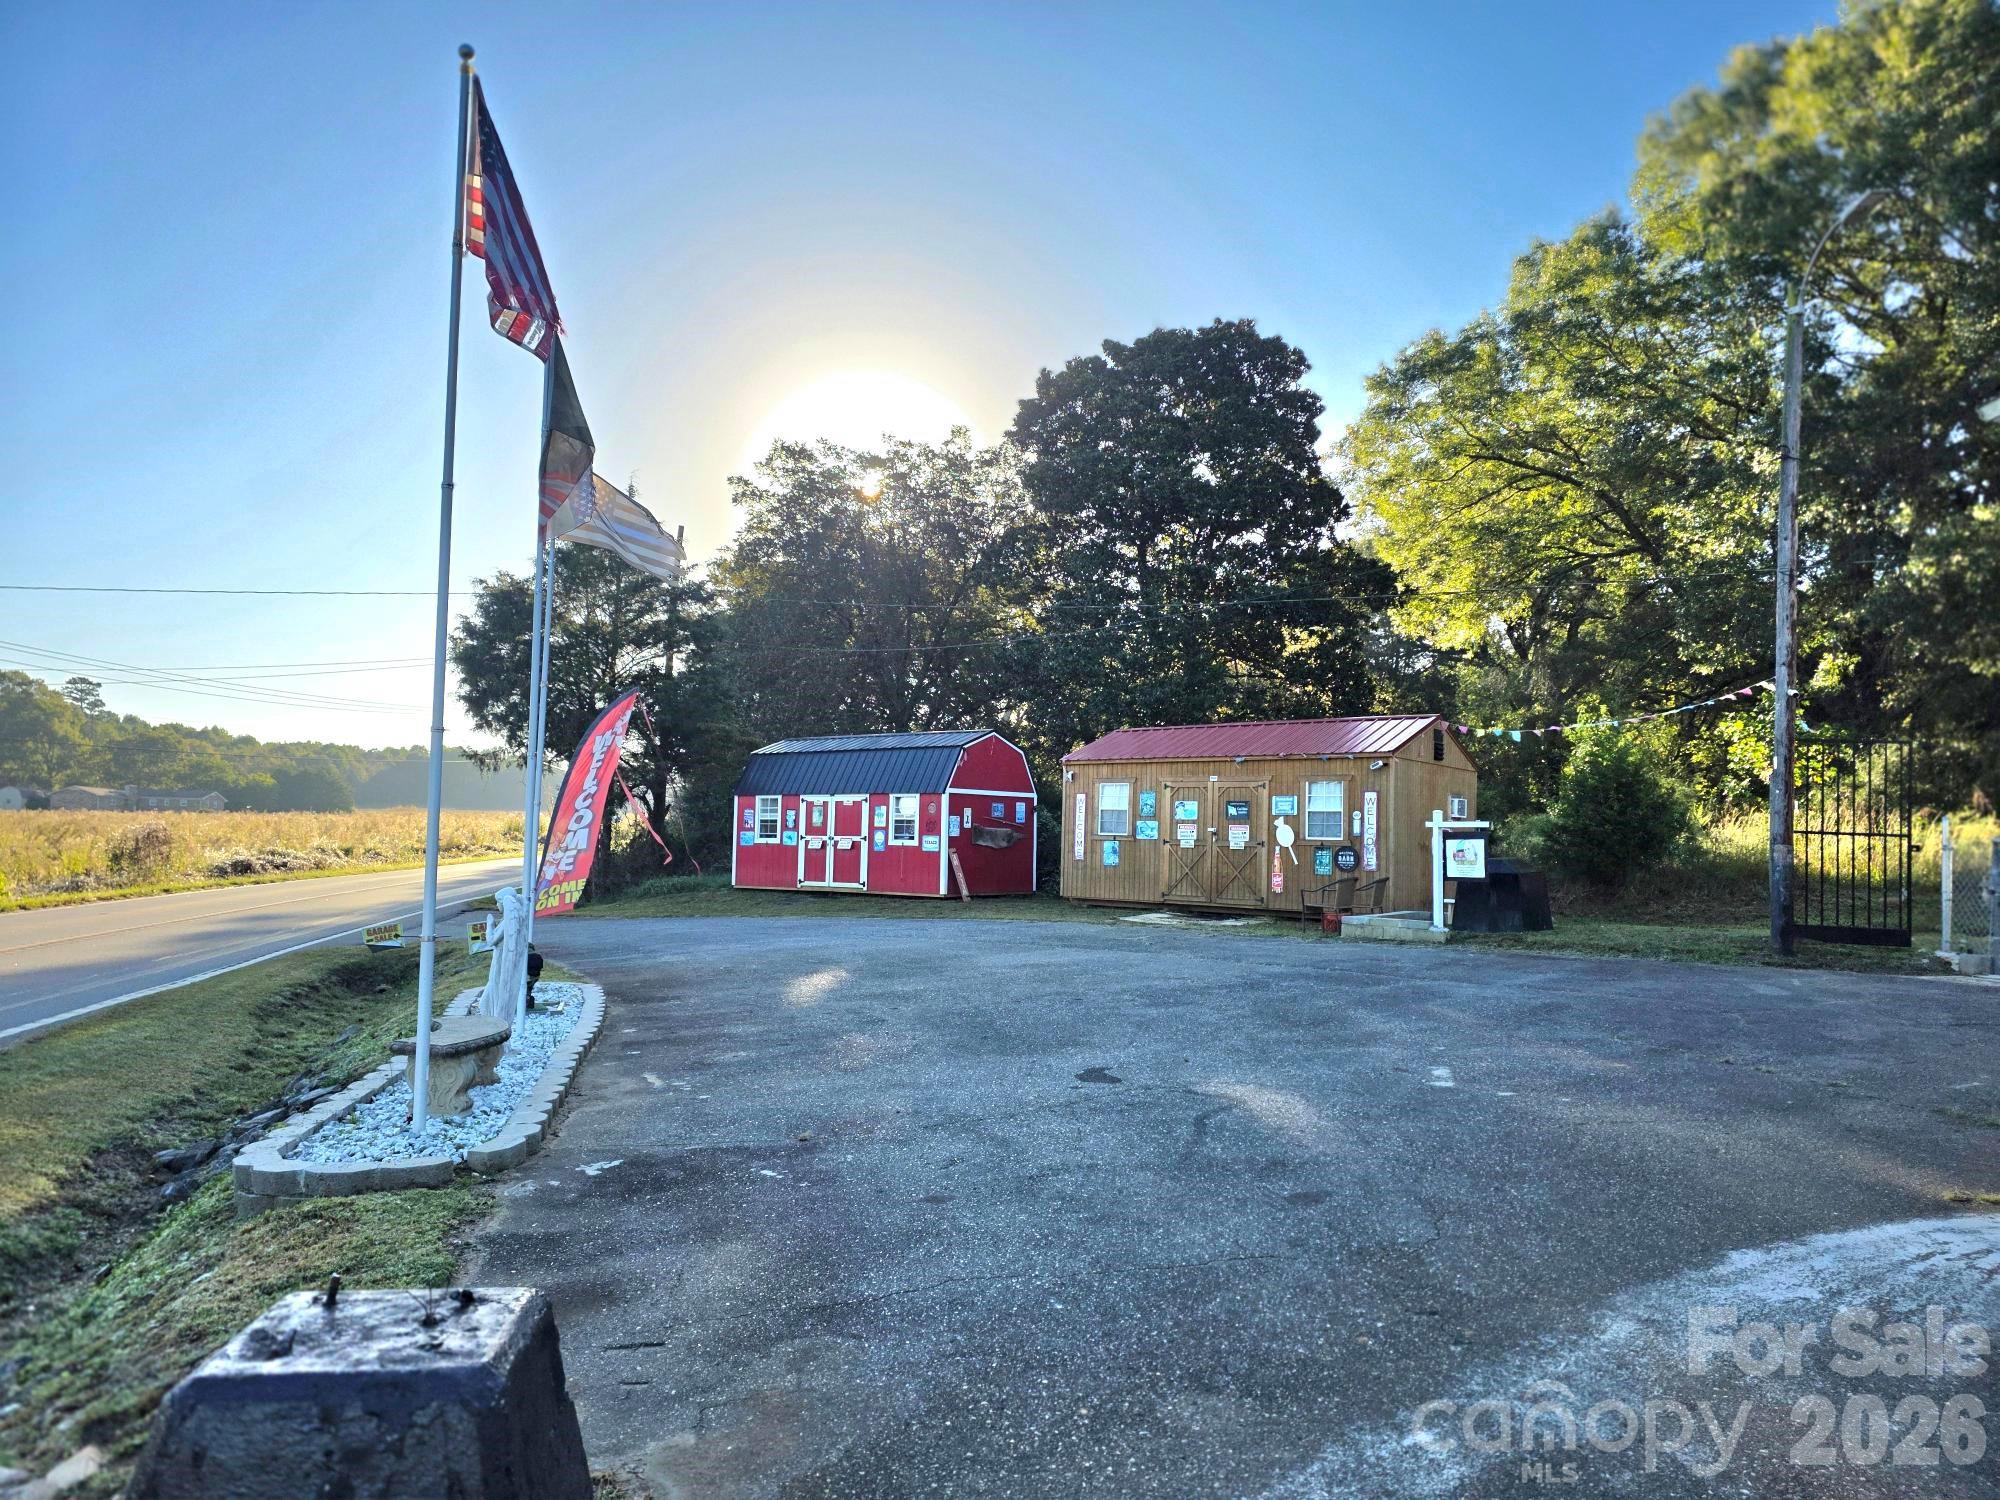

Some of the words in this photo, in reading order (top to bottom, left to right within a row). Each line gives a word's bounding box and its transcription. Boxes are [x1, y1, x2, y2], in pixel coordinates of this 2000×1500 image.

[560, 730, 615, 871] WELCOME
[1076, 798, 1085, 860] WELCOME
[1365, 797, 1376, 867] WELCOME
[535, 894, 560, 911] ON
[564, 889, 583, 904] IN
[538, 878, 586, 900] COME
[366, 924, 399, 937] GARAGE
[374, 933, 393, 943] SALE
